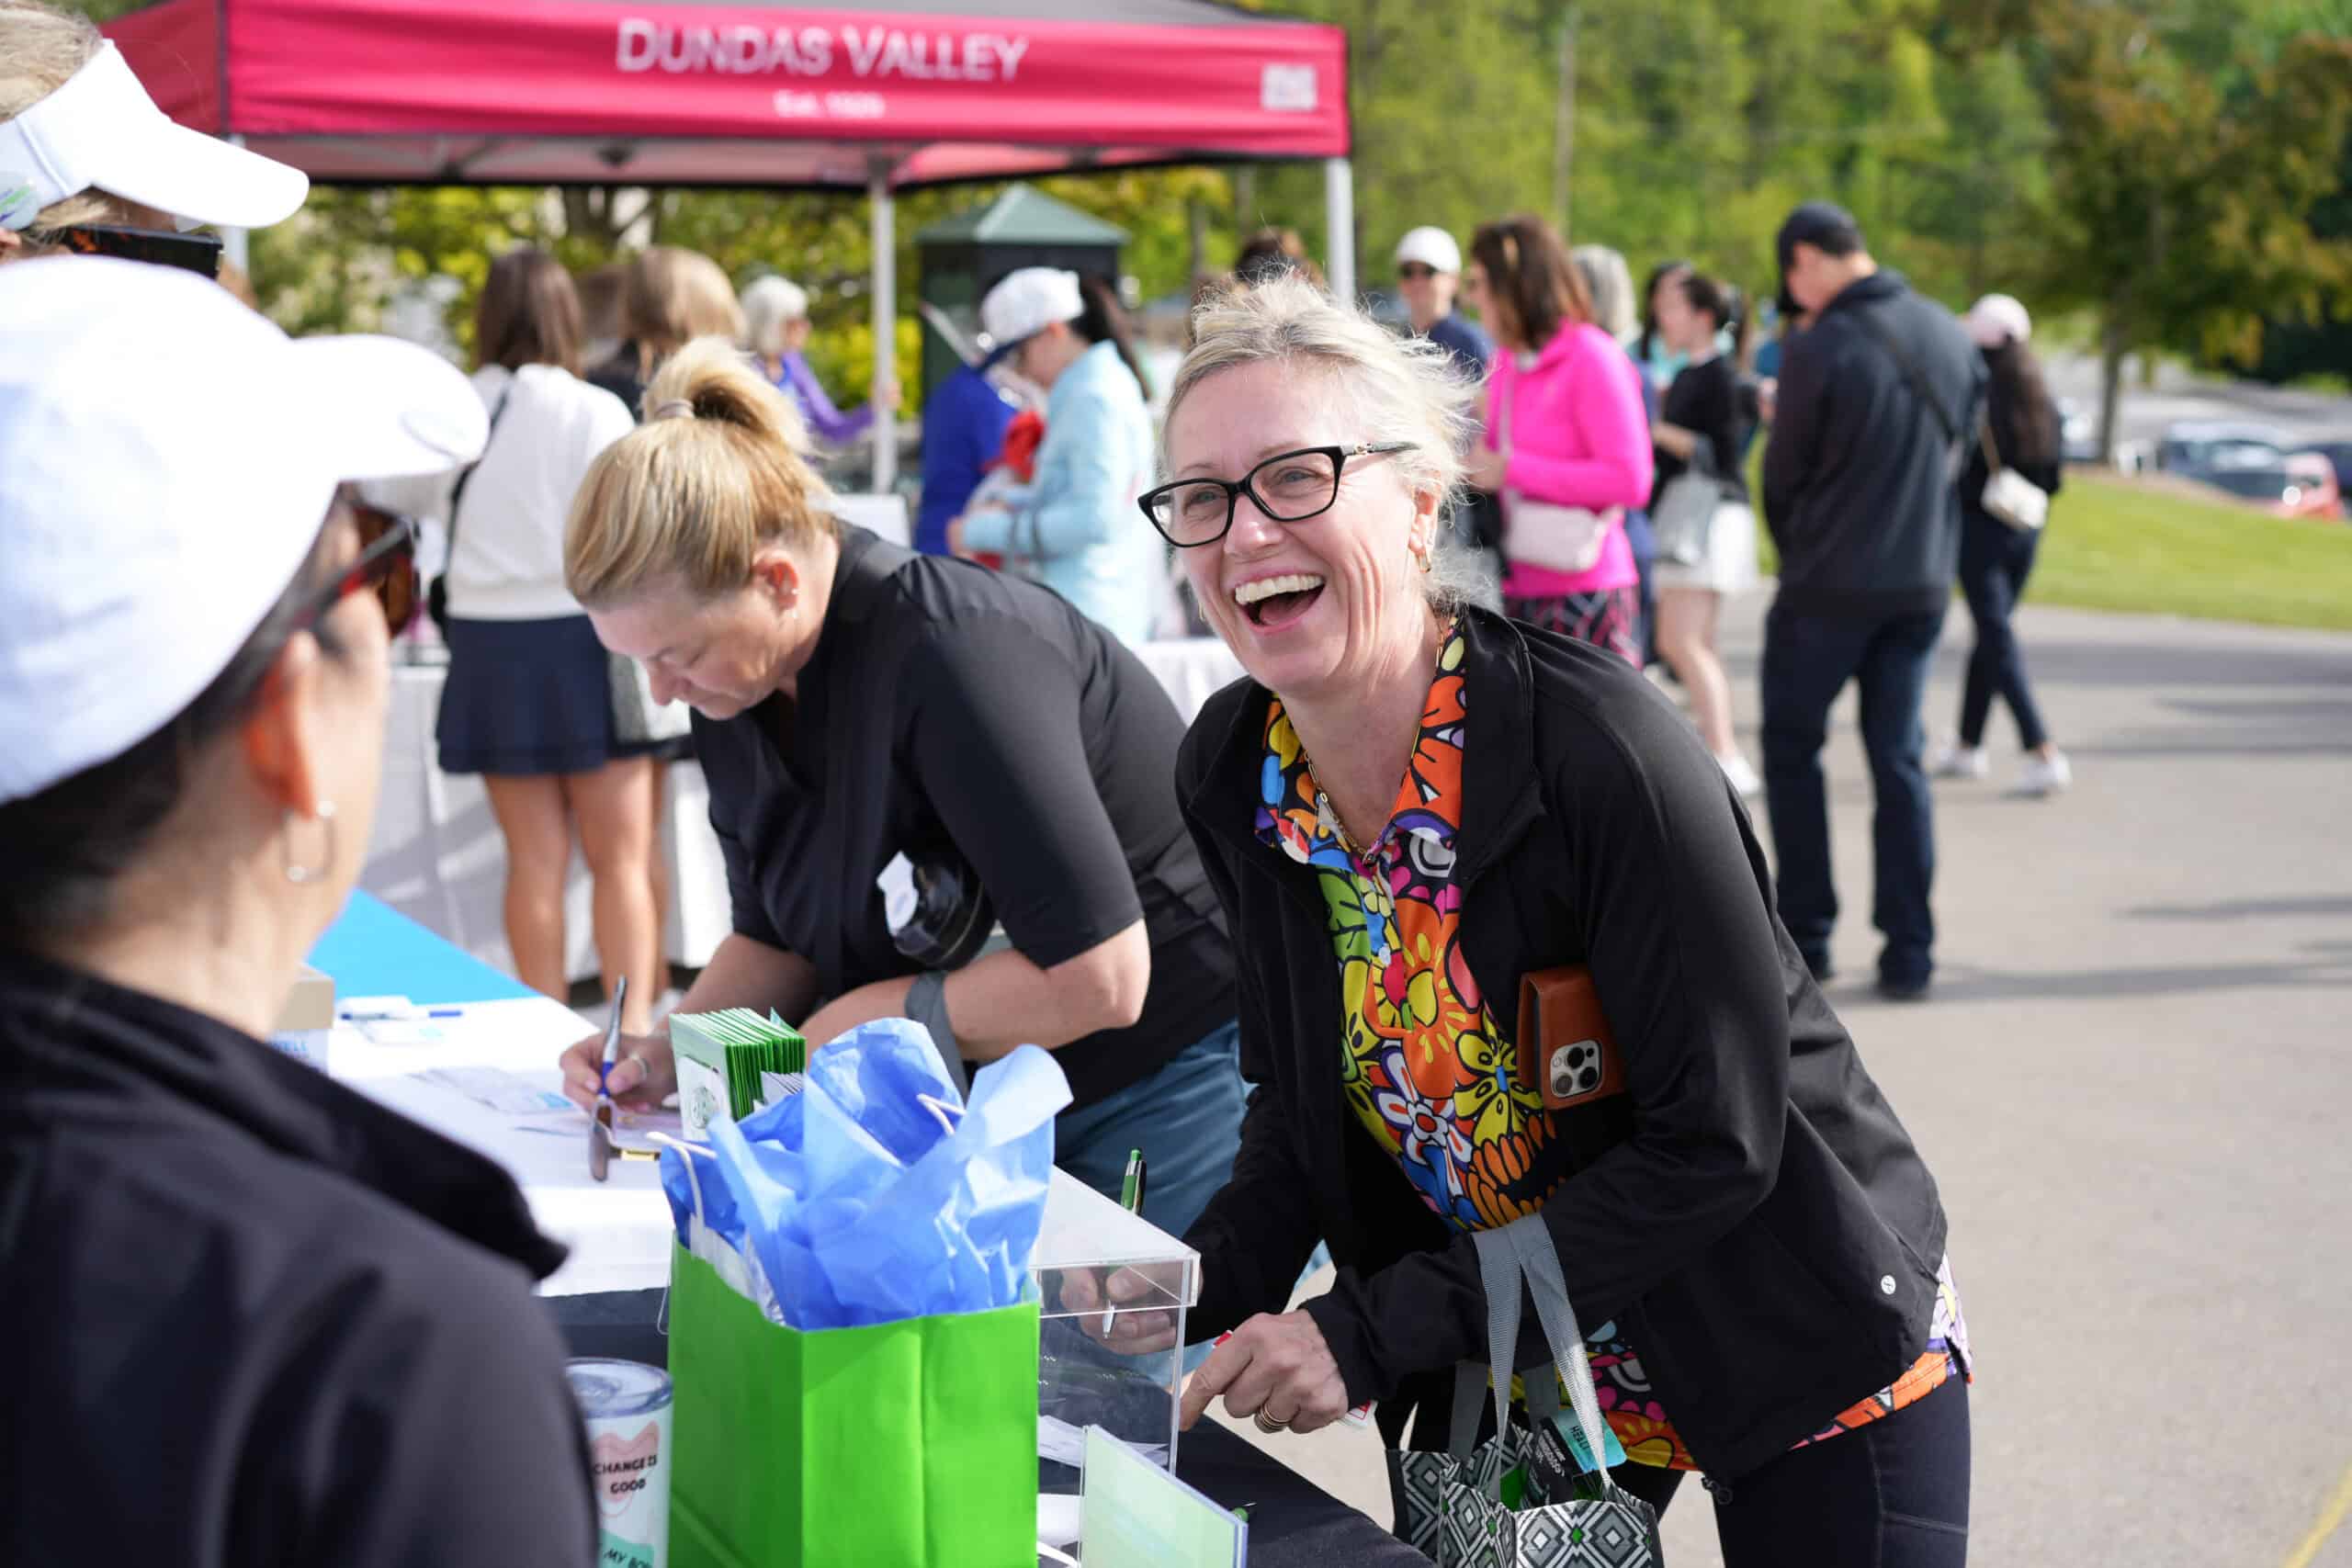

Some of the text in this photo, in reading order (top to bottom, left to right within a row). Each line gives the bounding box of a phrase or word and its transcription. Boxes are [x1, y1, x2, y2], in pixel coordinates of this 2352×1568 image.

[616, 17, 1028, 81] DUNDAS VALLEY
[609, 1478, 647, 1495] GOOD
